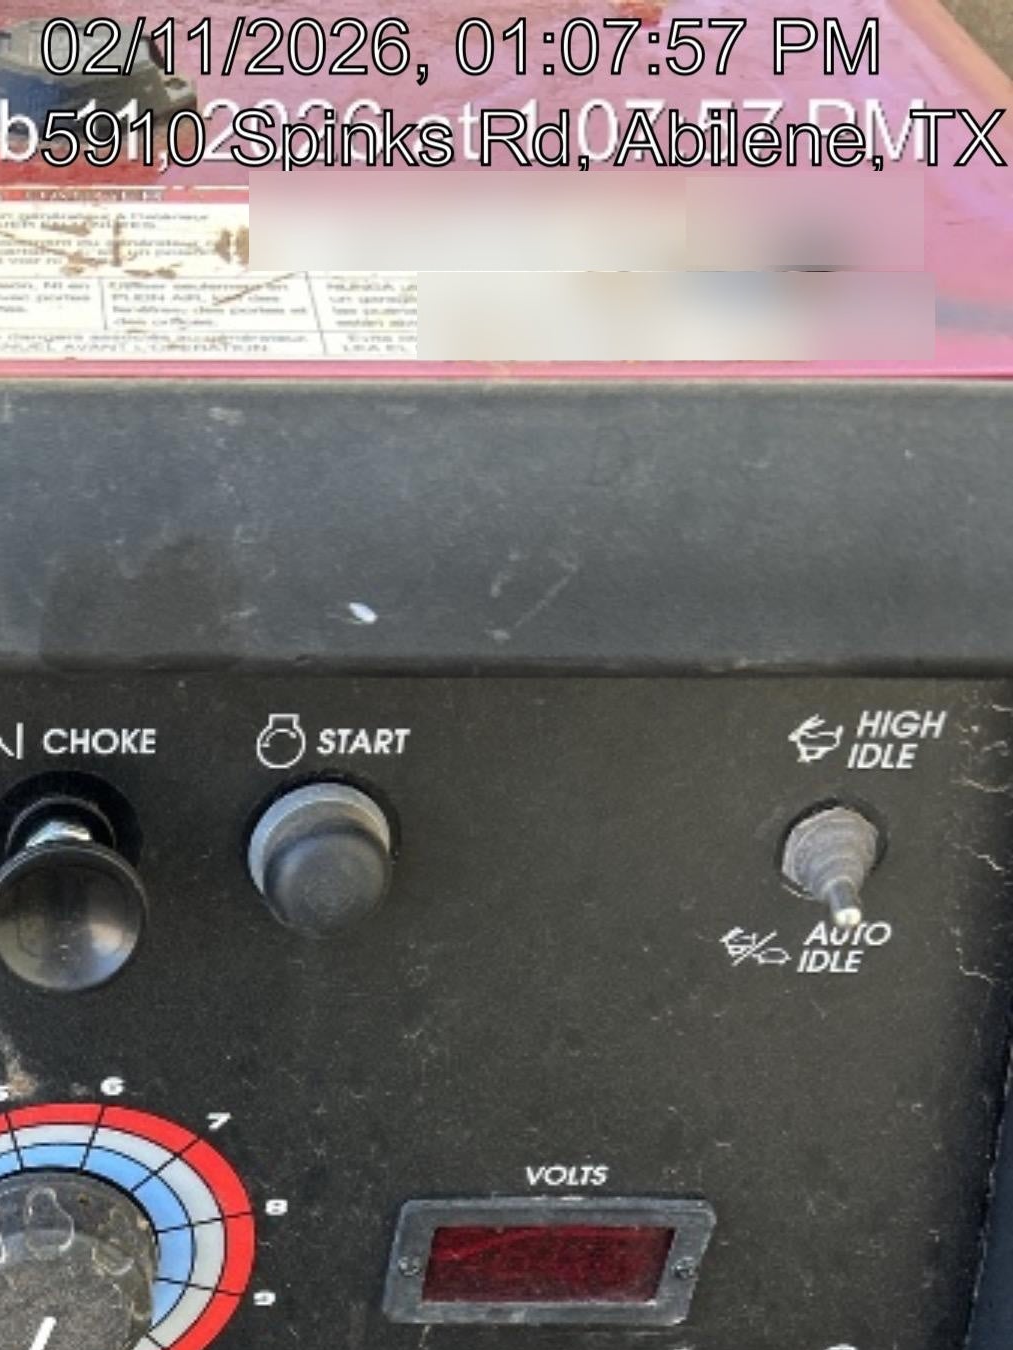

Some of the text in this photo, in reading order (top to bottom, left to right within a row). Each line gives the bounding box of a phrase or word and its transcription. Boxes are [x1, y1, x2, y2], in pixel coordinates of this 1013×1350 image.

[856, 710, 947, 739] HIGH
[42, 727, 157, 755] CHOKE
[315, 728, 412, 755] START
[847, 743, 918, 770] IDLE
[803, 921, 892, 946] AUTO
[796, 949, 864, 973] IDLE
[100, 1077, 125, 1095] 6
[206, 1113, 231, 1129] 7
[525, 1165, 610, 1187] VOLTS
[265, 1200, 289, 1215] 8
[253, 1291, 277, 1307] 9
